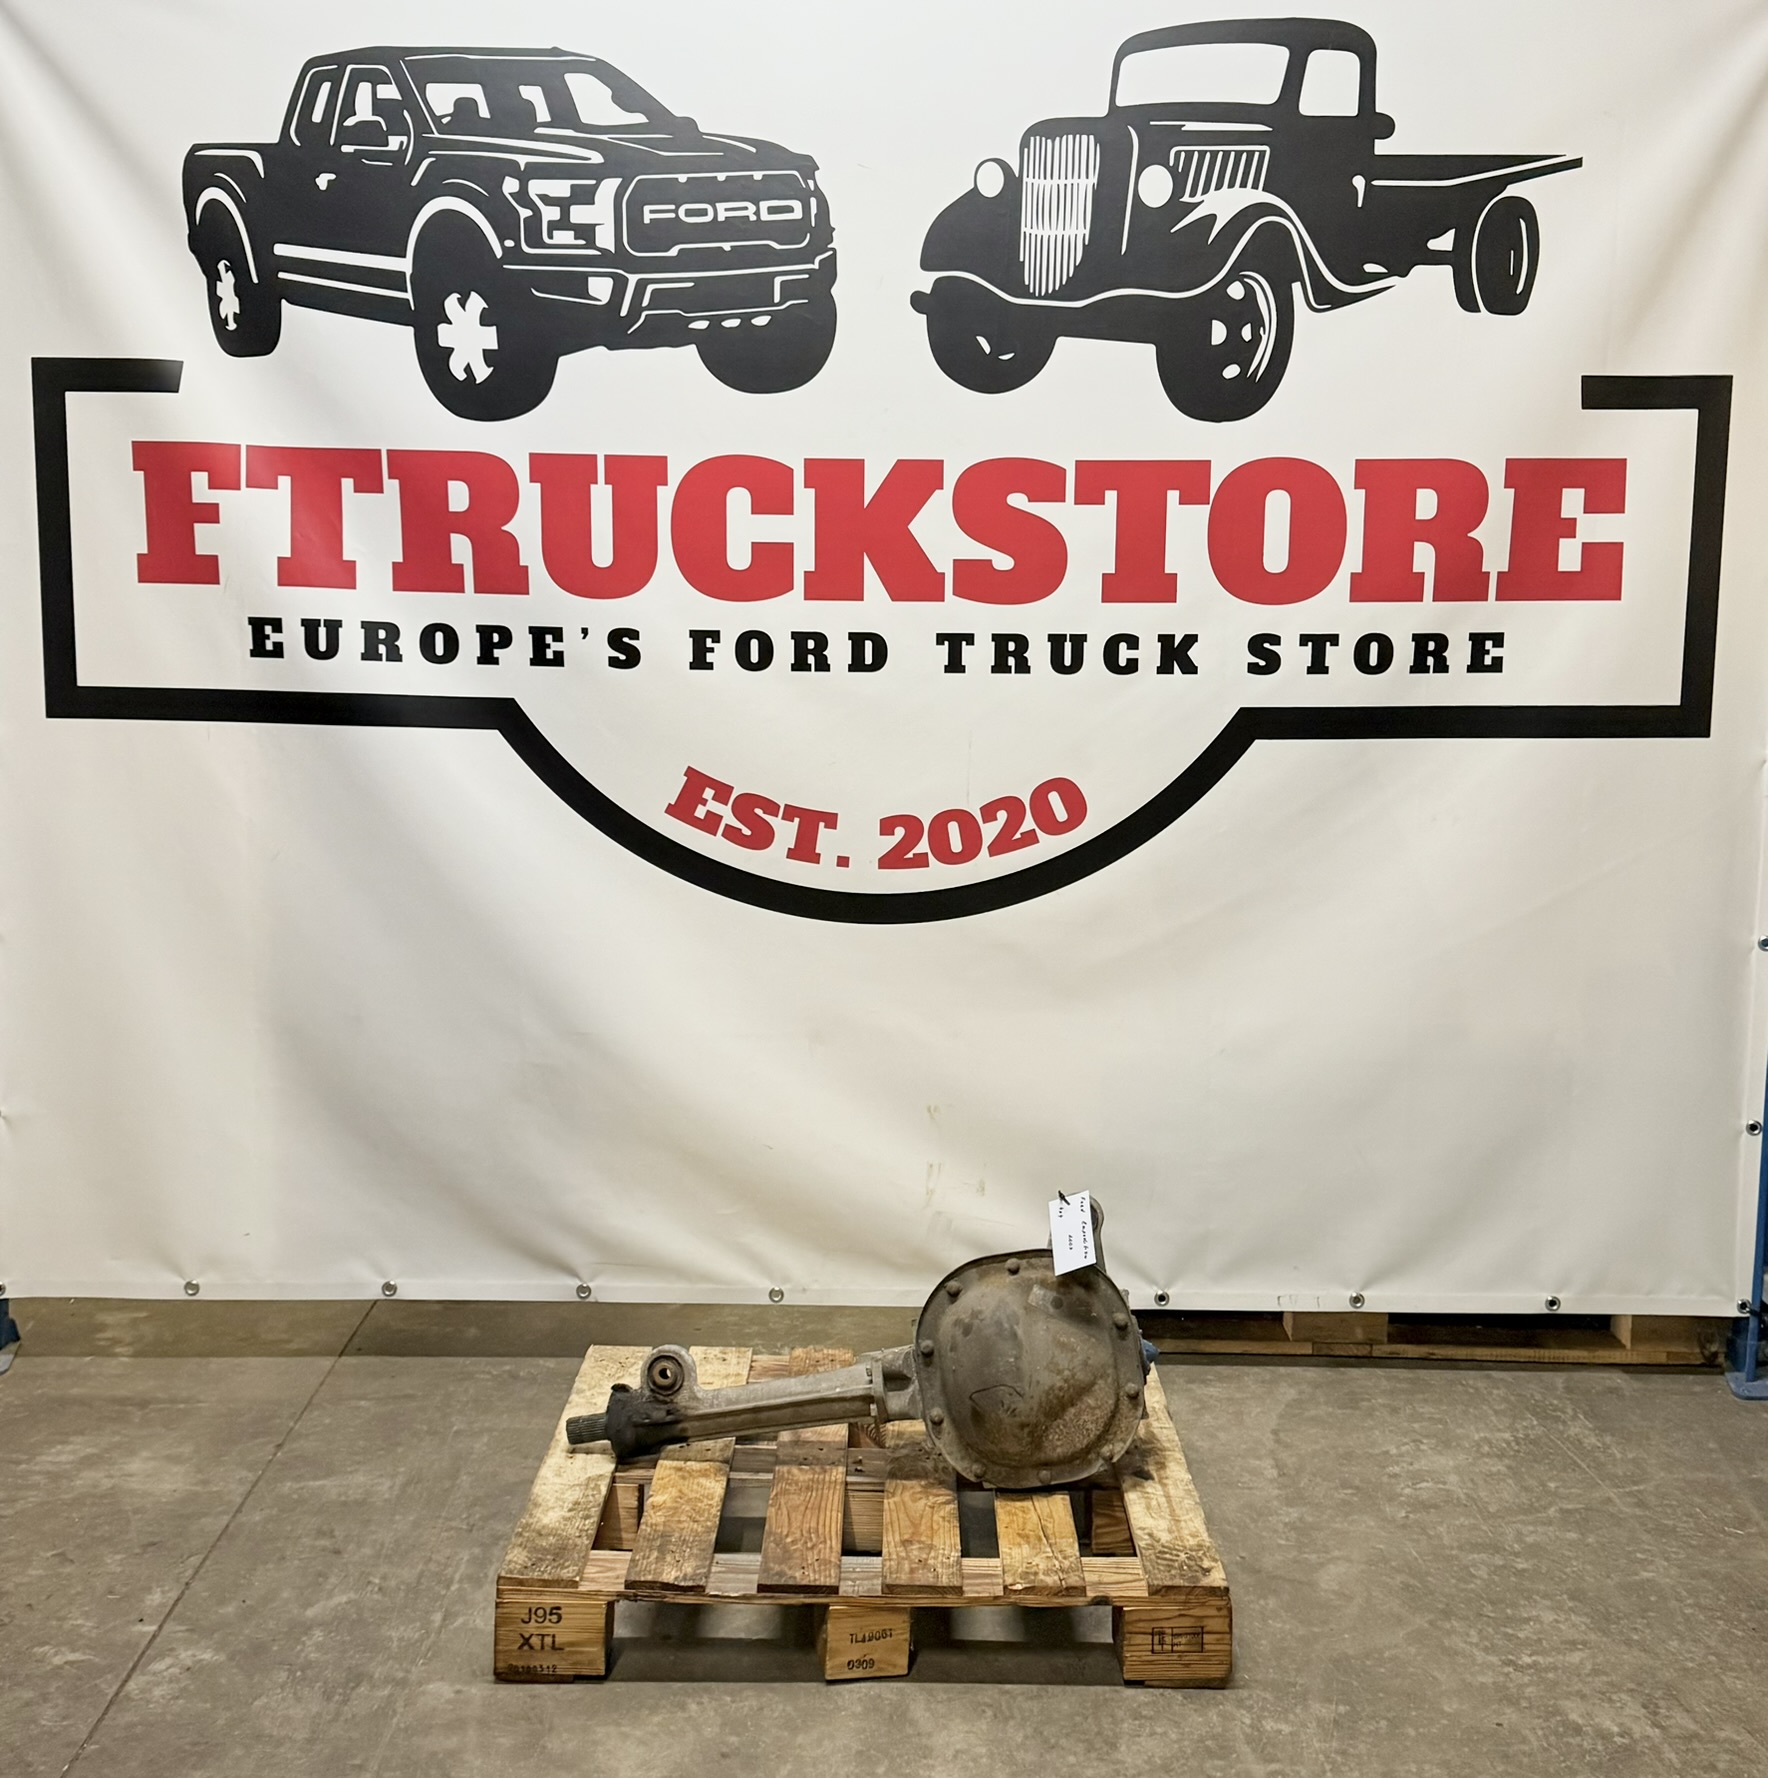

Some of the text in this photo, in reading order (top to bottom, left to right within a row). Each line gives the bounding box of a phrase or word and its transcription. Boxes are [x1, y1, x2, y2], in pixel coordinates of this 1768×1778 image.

[643, 200, 803, 224] FORD
[131, 440, 1627, 605] FTRUCKSTORE
[248, 616, 1505, 675] EUROPE'S FORD TRUCK STORE
[664, 765, 1088, 869] EST. 2020
[520, 1606, 563, 1625] J95
[517, 1633, 565, 1651] XTL
